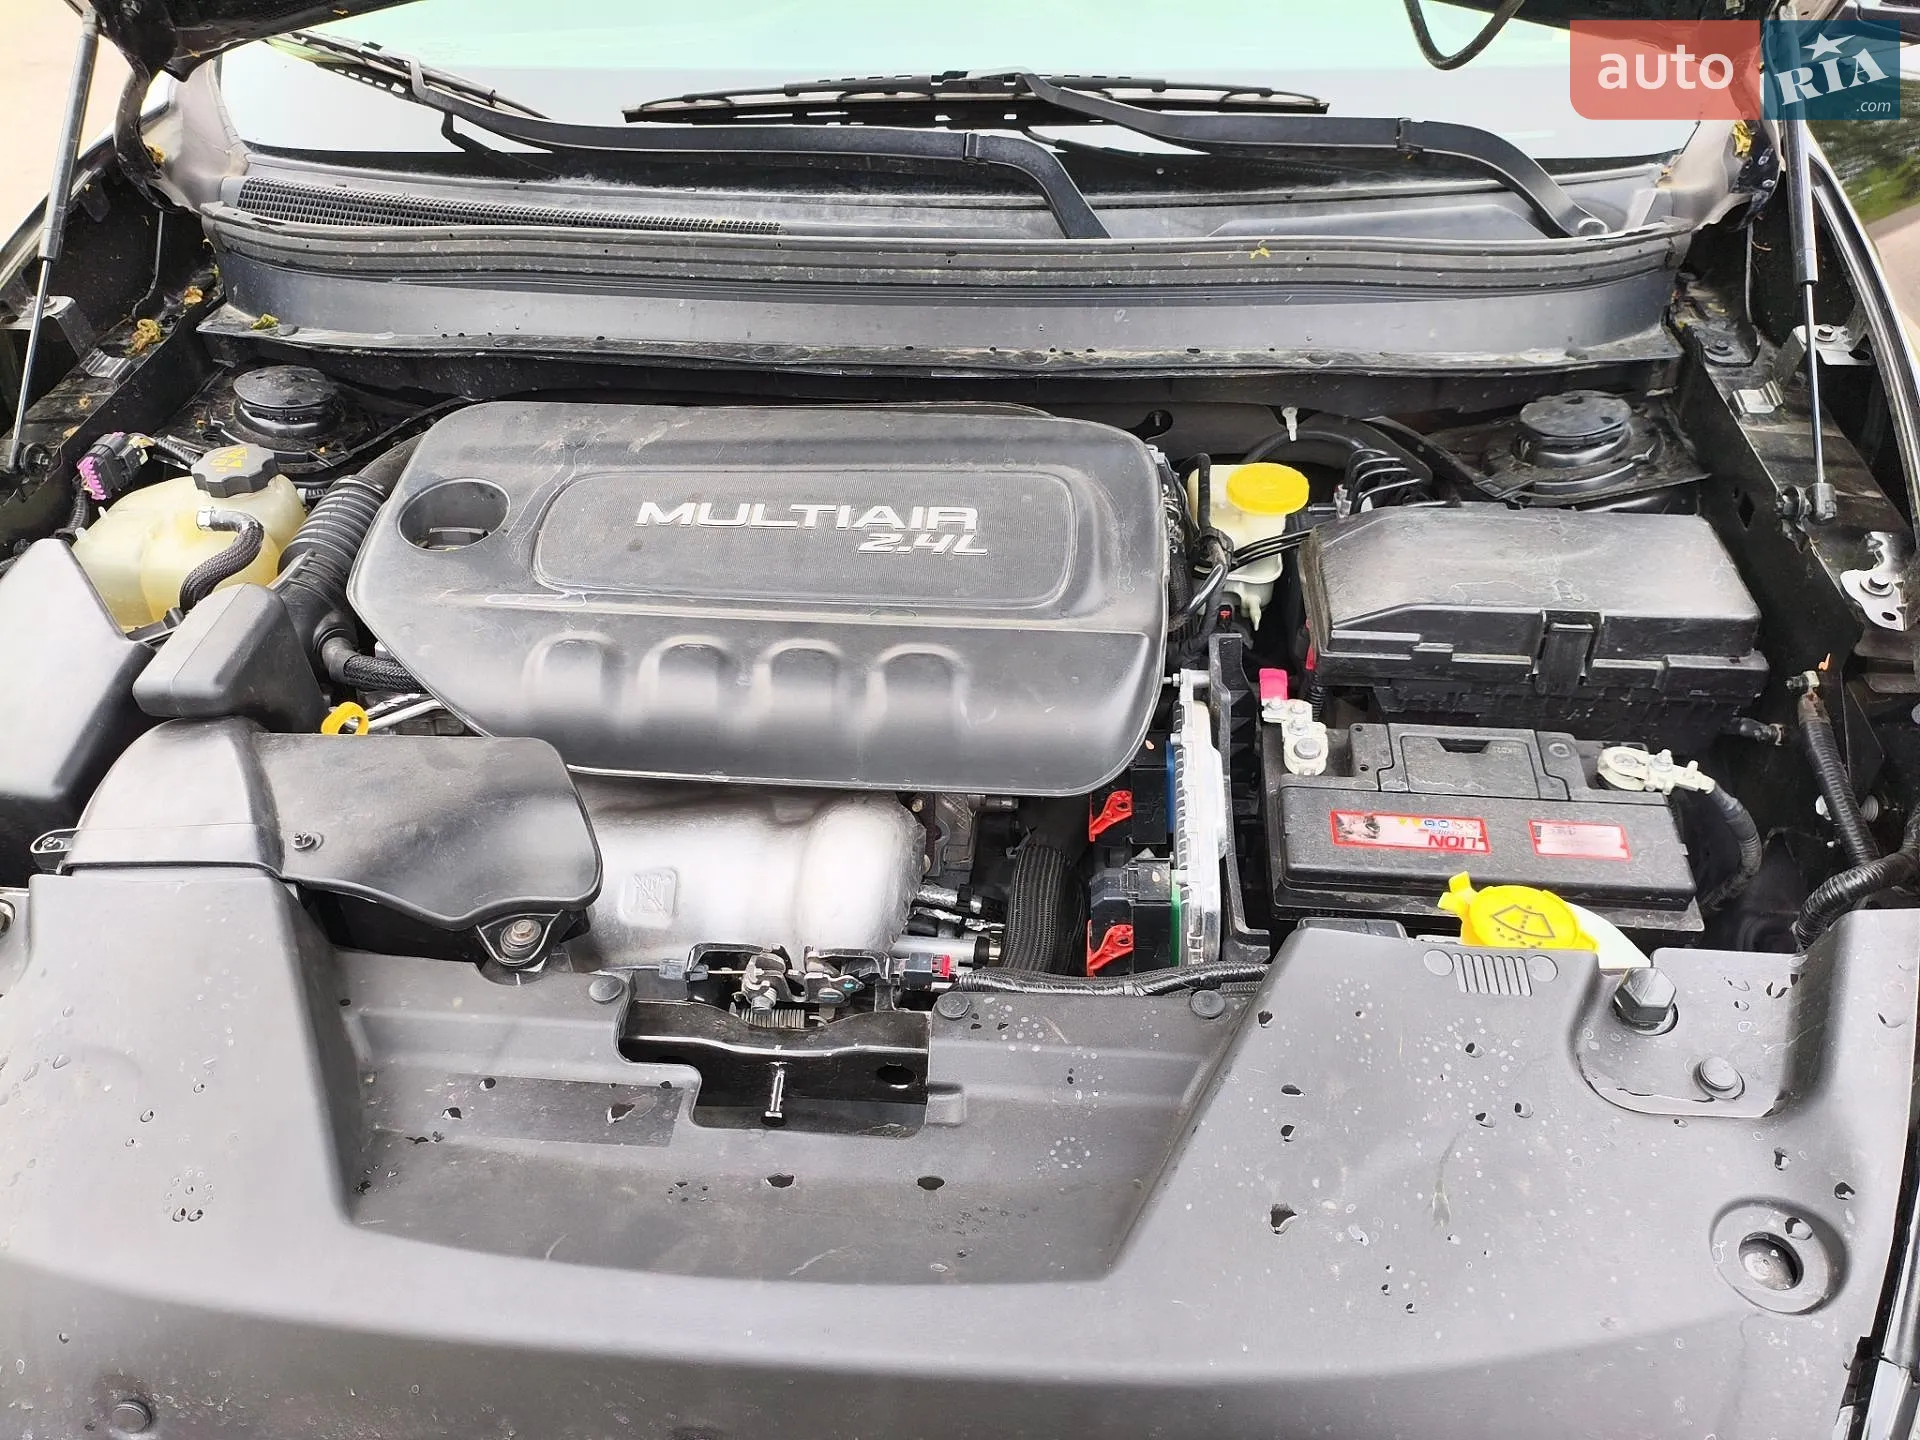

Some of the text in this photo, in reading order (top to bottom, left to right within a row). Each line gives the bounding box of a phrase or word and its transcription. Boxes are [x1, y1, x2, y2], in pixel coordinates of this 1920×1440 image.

[634, 501, 980, 532] MULTIAIR
[857, 532, 989, 556] 2.4L
[1428, 834, 1477, 849] LION
